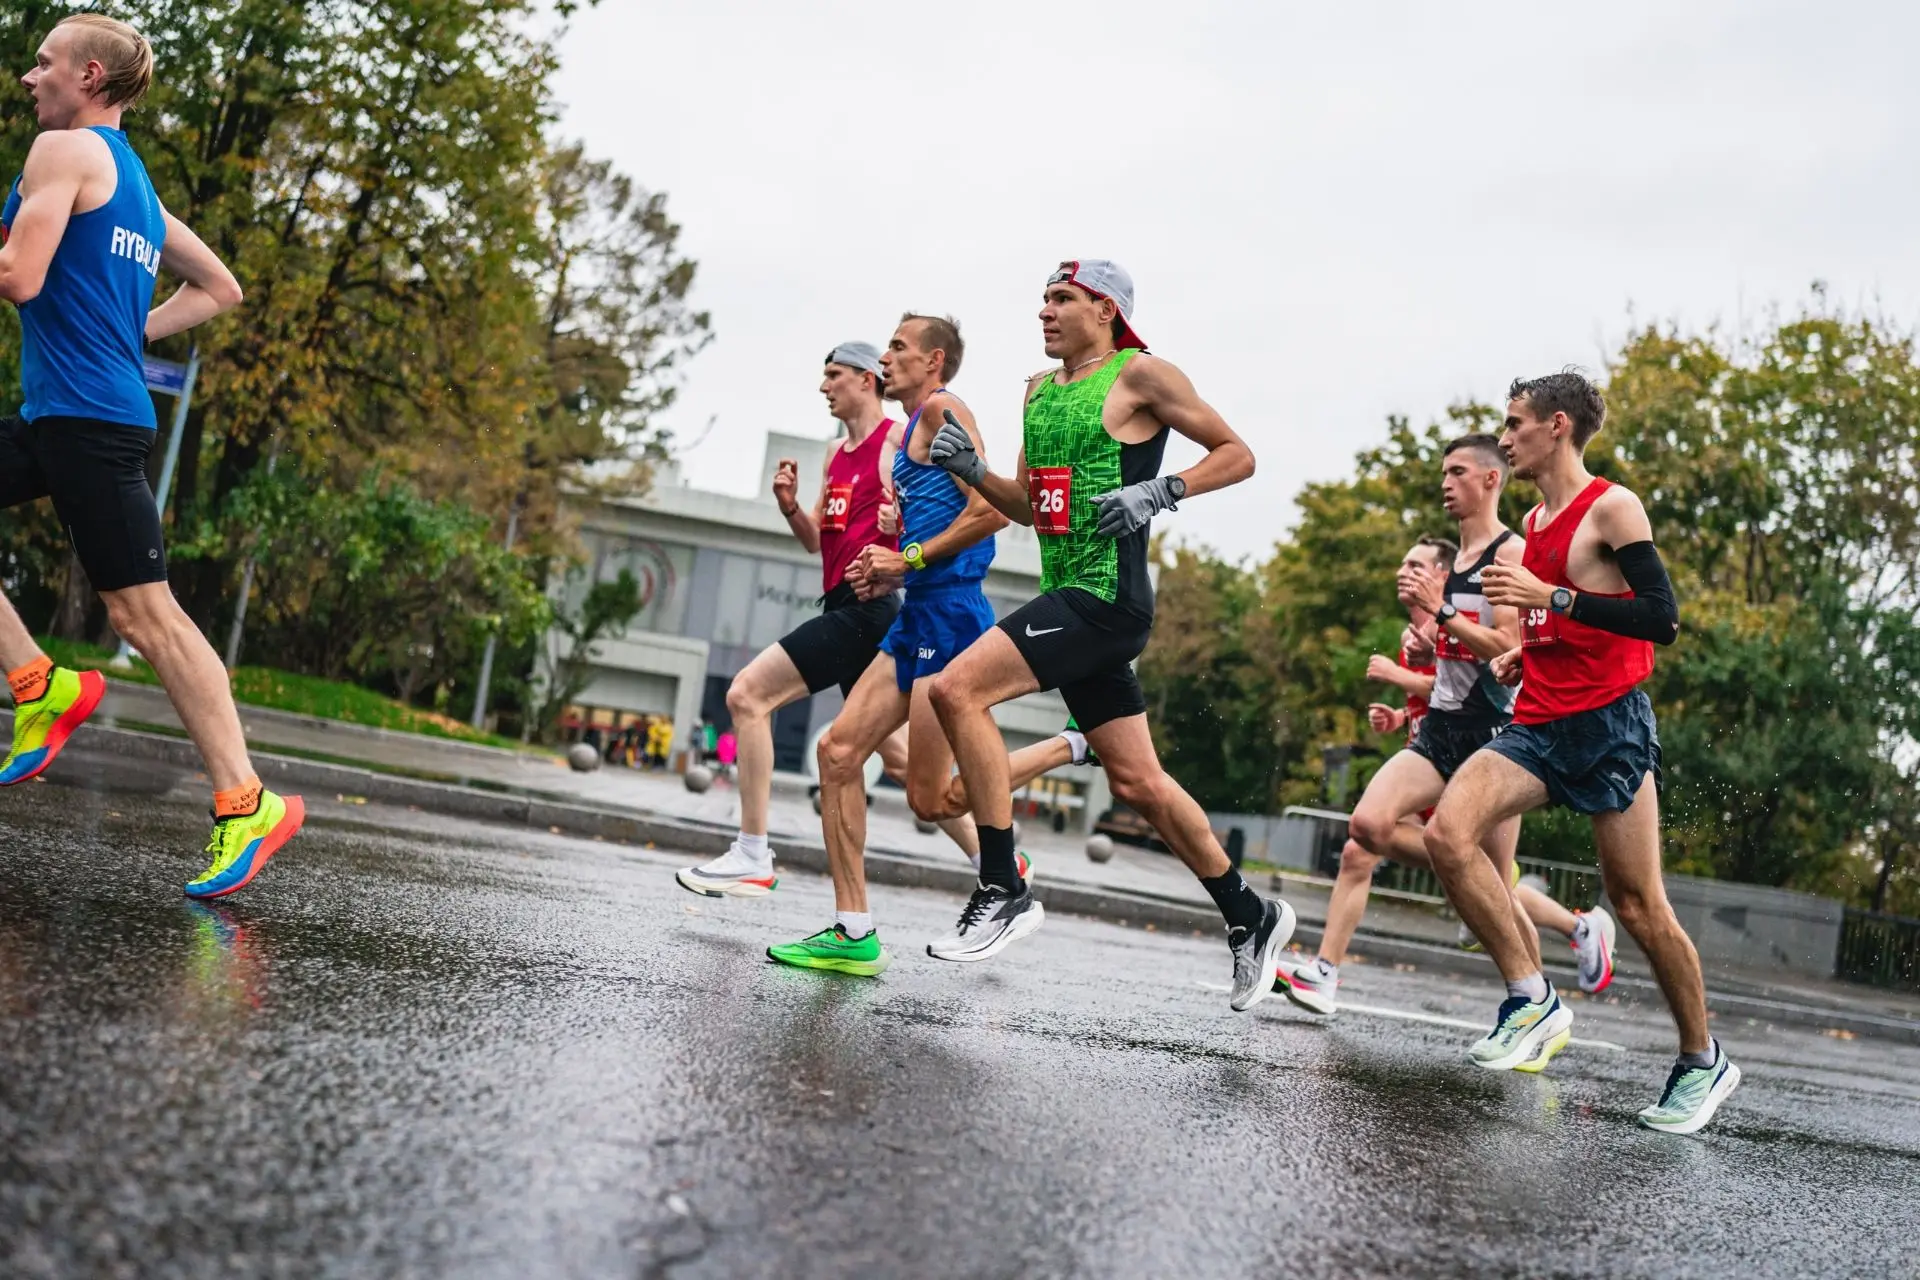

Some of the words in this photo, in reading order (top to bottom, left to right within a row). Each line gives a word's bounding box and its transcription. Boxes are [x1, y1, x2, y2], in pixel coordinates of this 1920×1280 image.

[826, 497, 847, 516] 20
[1039, 488, 1064, 513] 26
[1528, 608, 1547, 627] 39
